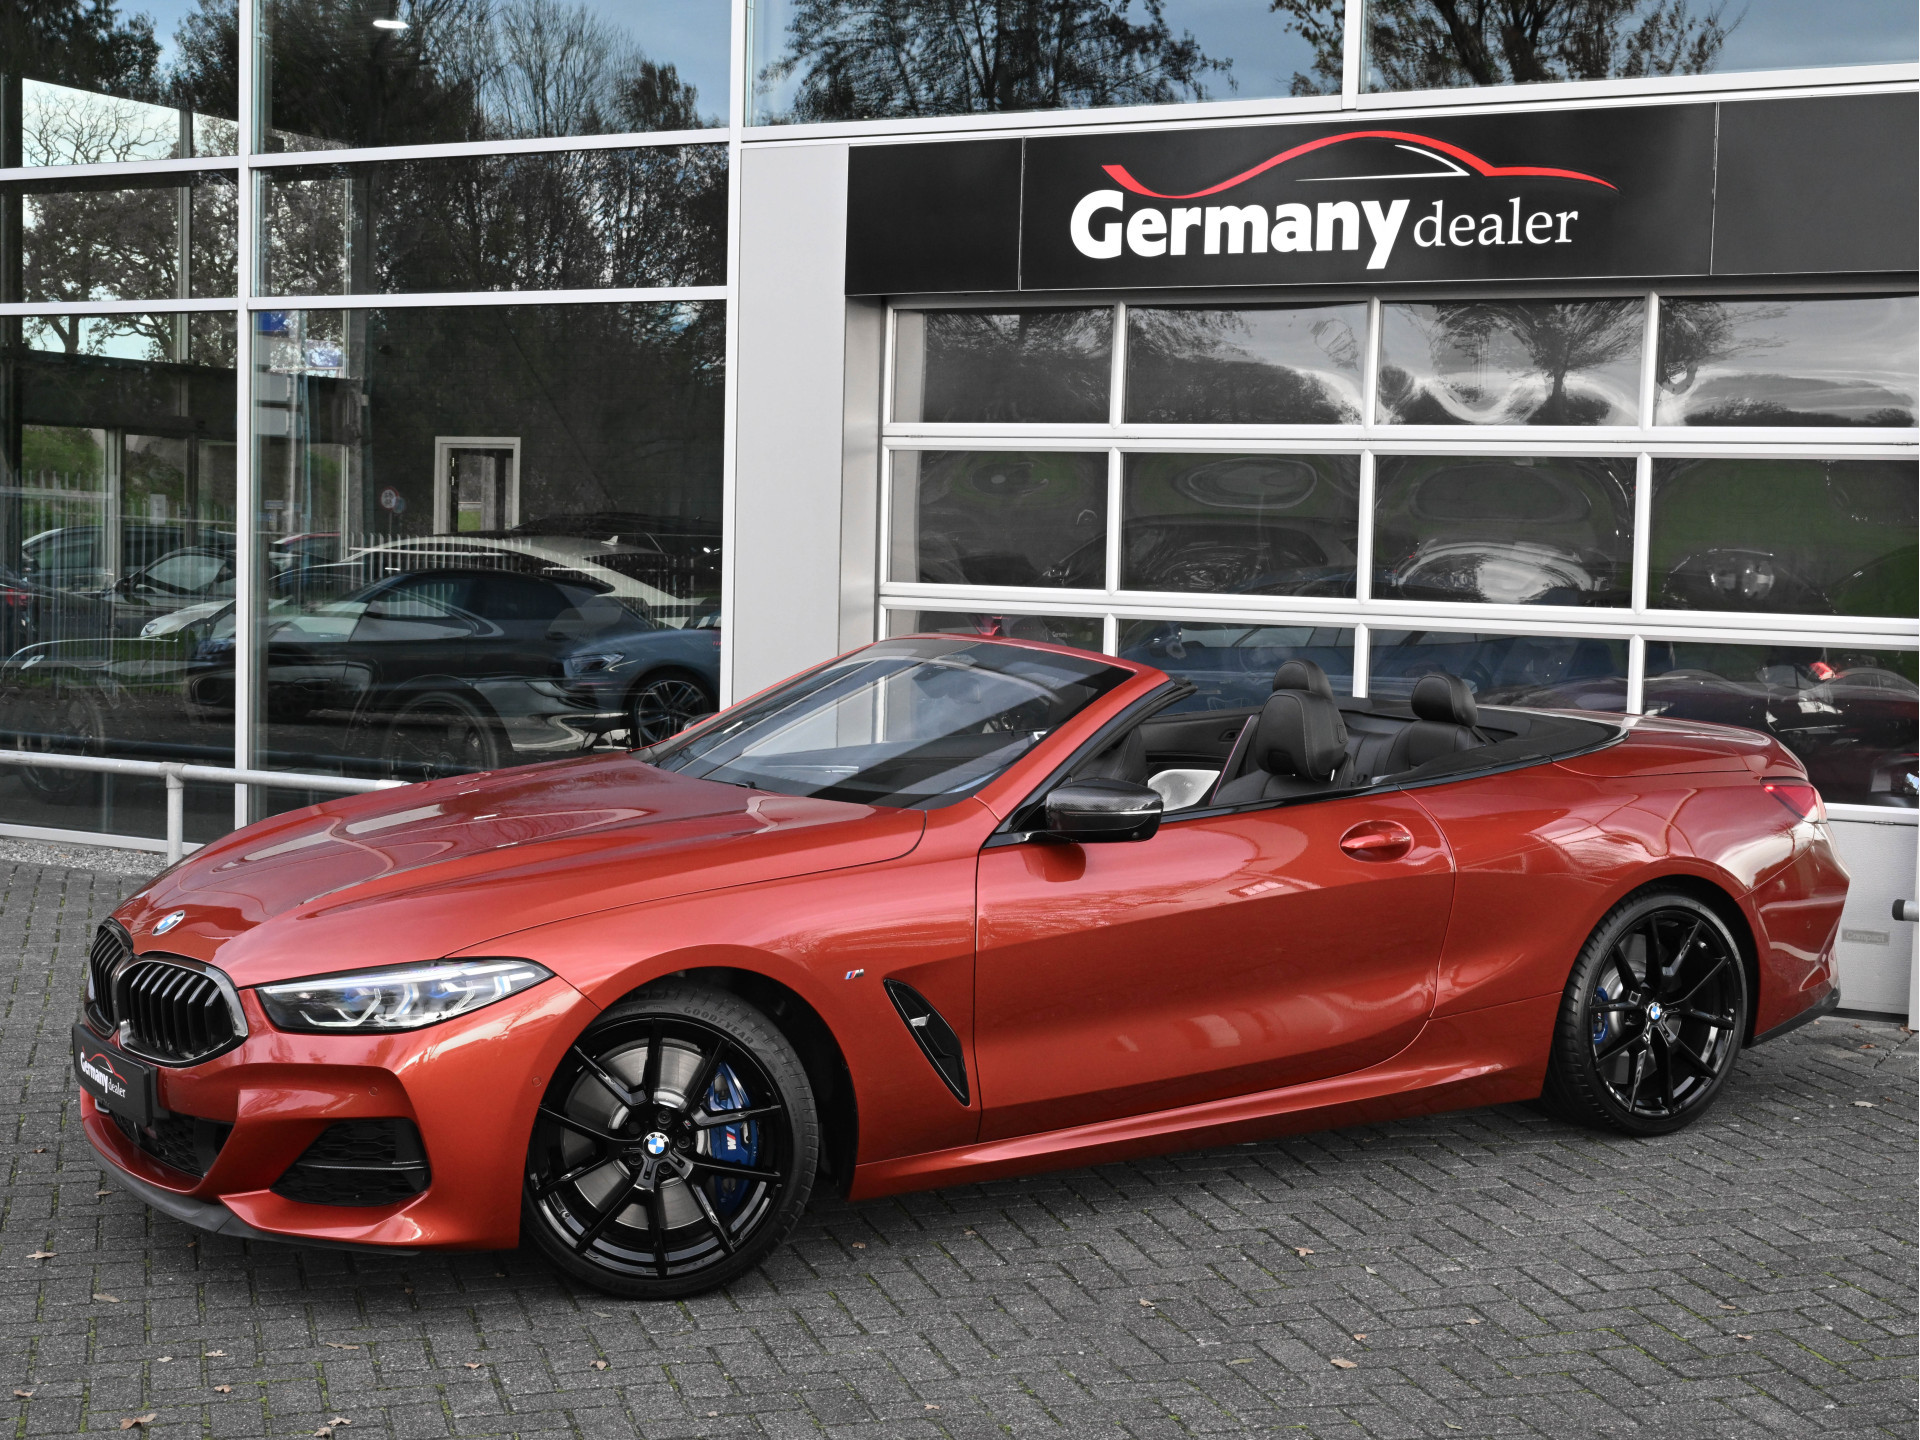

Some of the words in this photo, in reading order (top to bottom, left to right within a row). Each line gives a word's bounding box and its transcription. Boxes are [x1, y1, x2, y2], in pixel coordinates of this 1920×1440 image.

[1070, 190, 1410, 269] Germany
[1413, 197, 1578, 247] dealer
[684, 1006, 754, 1044] GOODYEAR
[80, 1052, 108, 1093] Germany
[108, 1078, 126, 1098] dealer
